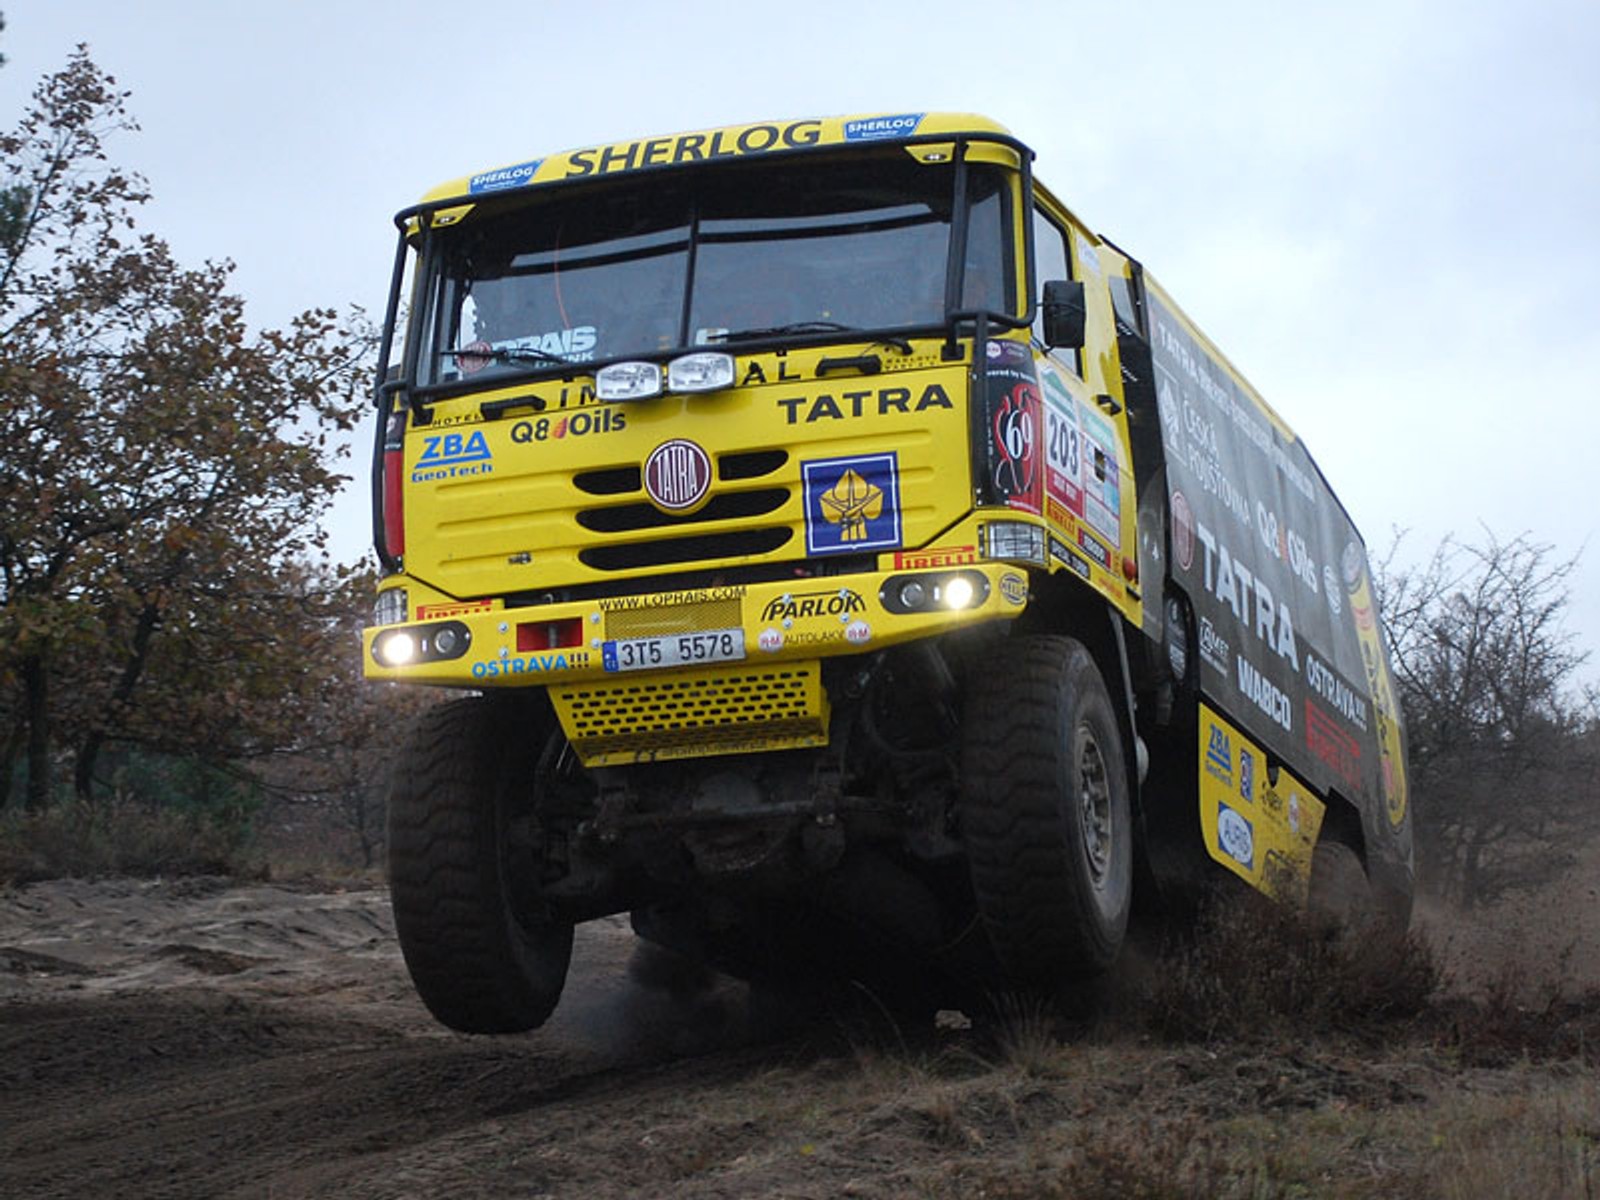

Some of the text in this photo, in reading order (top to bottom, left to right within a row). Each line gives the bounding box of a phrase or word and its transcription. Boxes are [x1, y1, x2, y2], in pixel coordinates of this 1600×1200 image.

[848, 118, 915, 134] SHERLOG
[566, 119, 821, 178] SHERLOG
[472, 165, 533, 186] SHERLOG
[776, 383, 954, 425] TATRA
[510, 412, 627, 444] Q8 Oils
[1049, 412, 1079, 477] 203
[420, 430, 492, 461] ZBA
[654, 445, 698, 503] TATRA
[894, 545, 975, 570] PIRELLI
[768, 595, 859, 621] PARLOK
[1198, 525, 1300, 673] TATRA
[622, 633, 734, 667] 3T5 5578
[1237, 654, 1292, 732] WABCO
